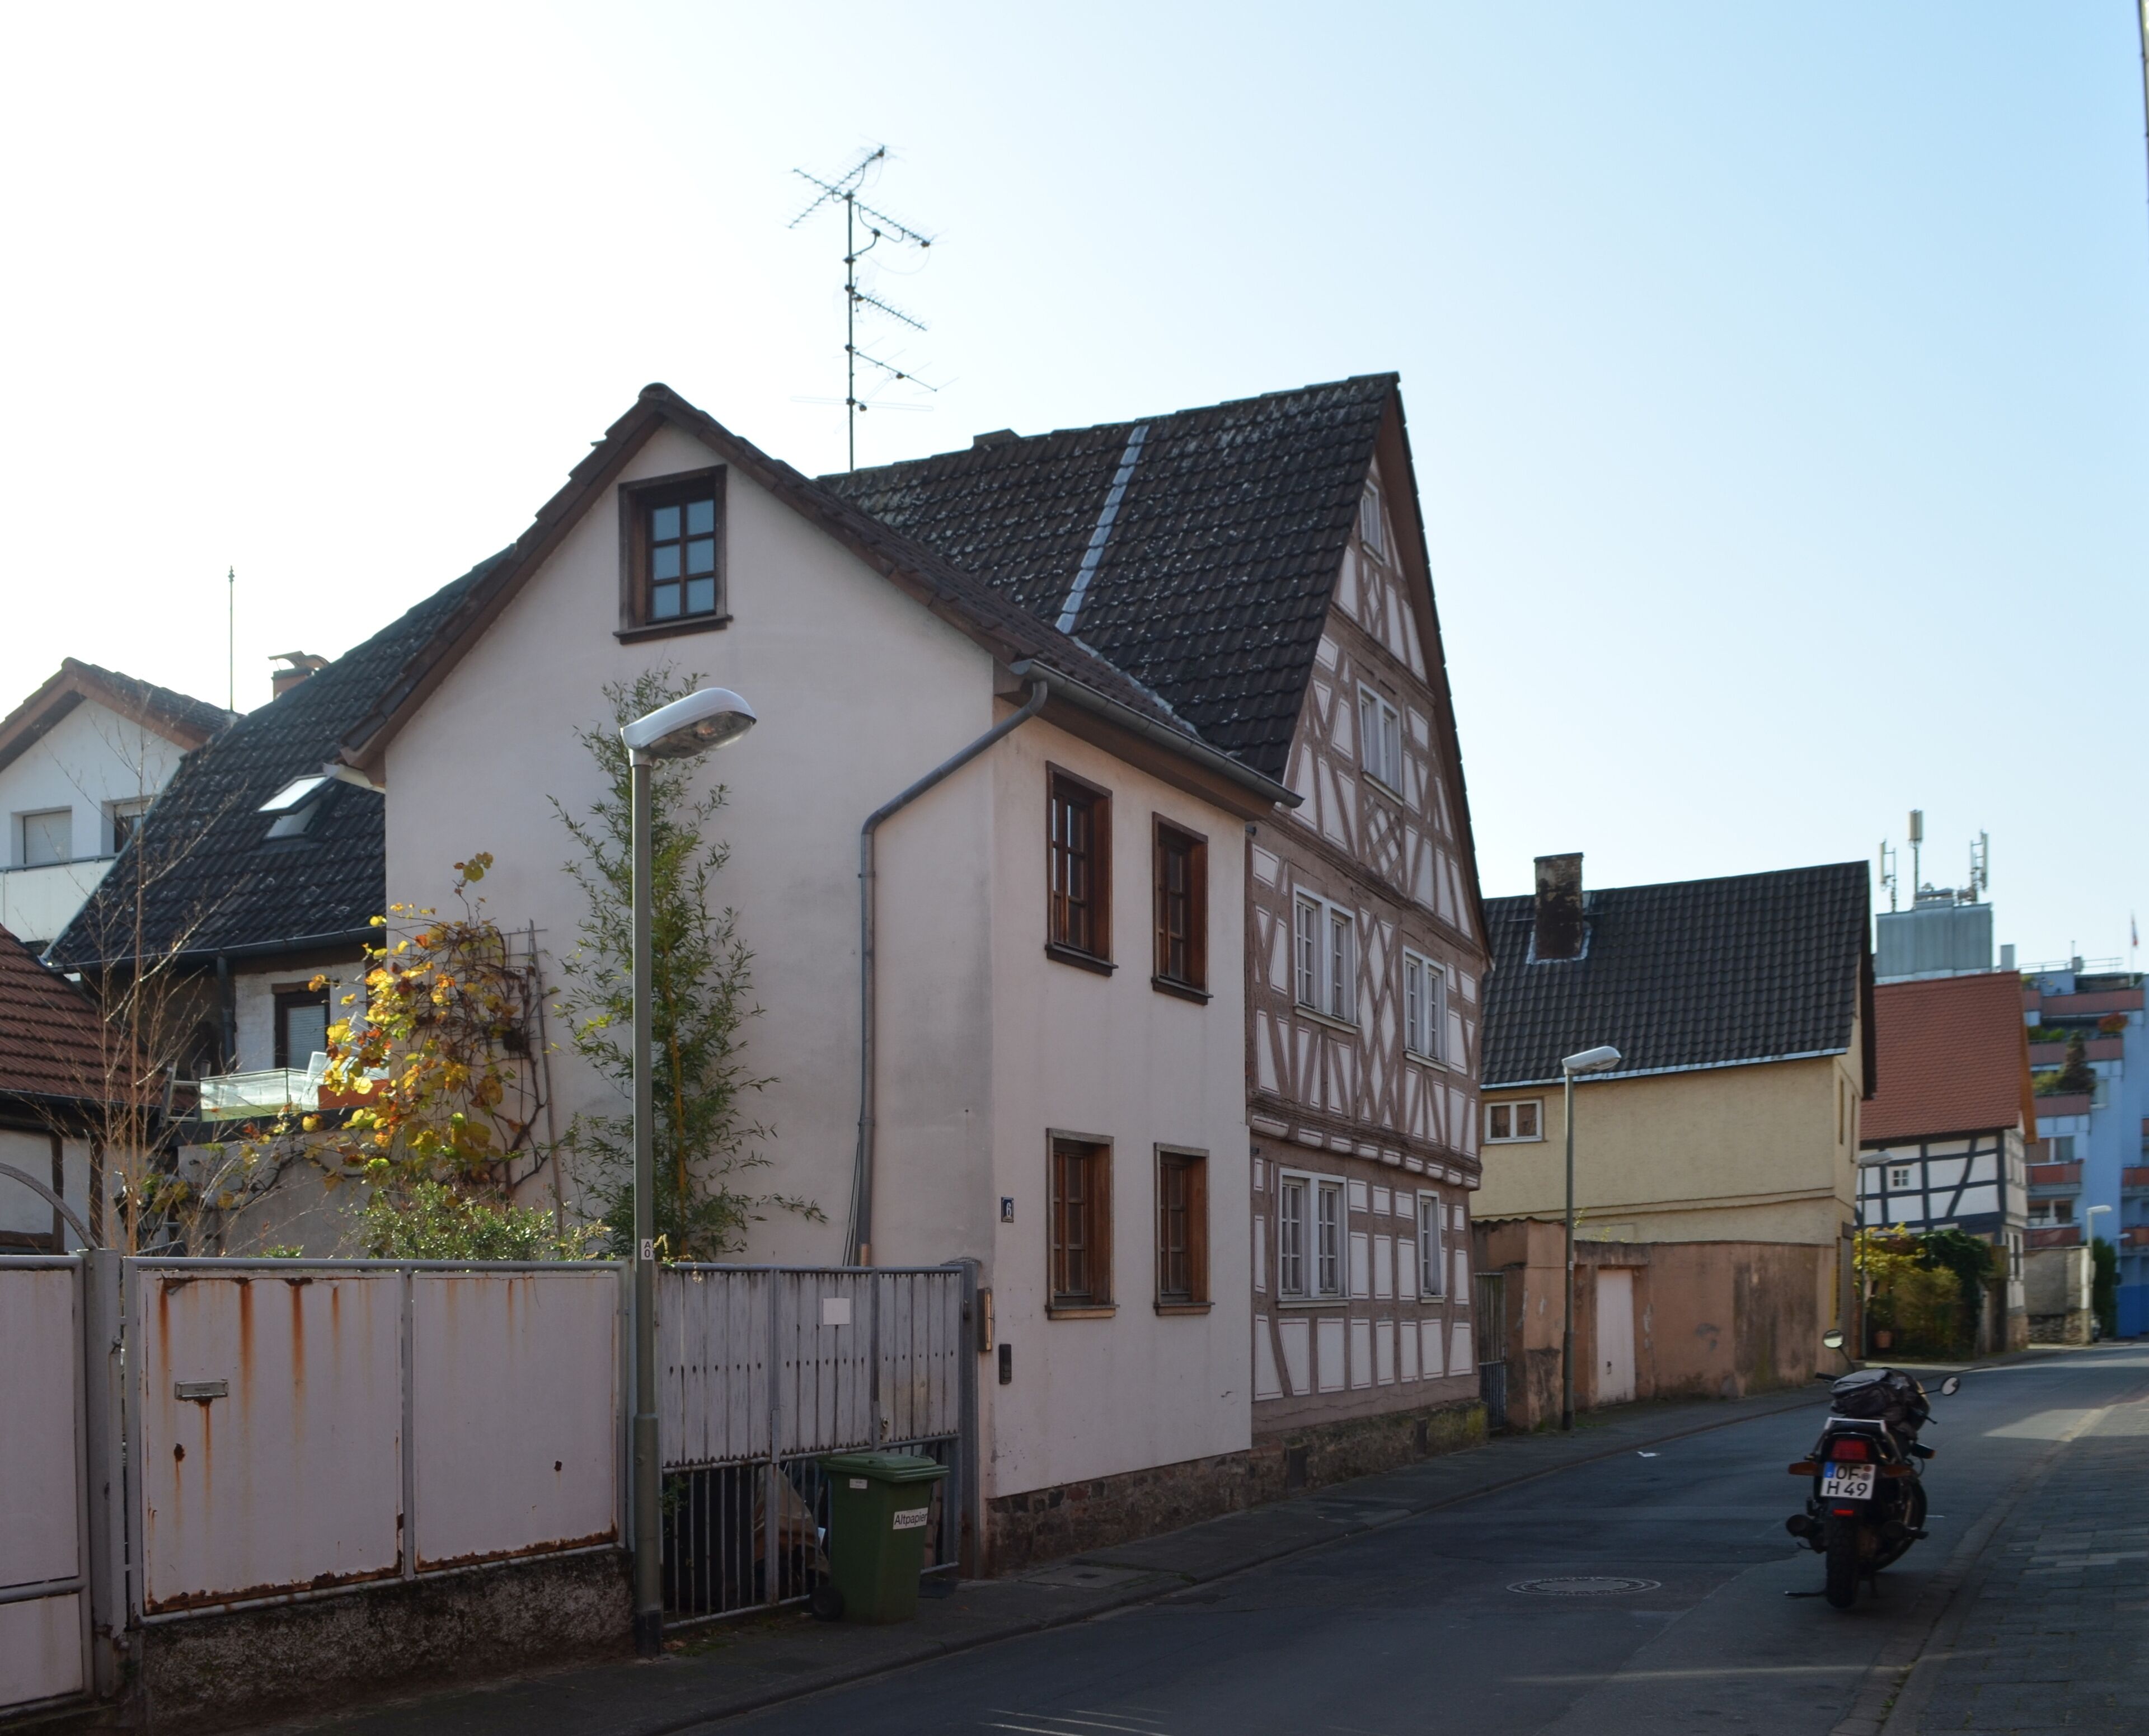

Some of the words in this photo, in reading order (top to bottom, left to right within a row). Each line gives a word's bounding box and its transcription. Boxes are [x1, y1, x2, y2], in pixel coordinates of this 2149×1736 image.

[1006, 1202, 1012, 1217] 6
[644, 1241, 651, 1249] A
[1836, 1466, 1861, 1480] OF
[1826, 1480, 1840, 1495] H
[1843, 1481, 1868, 1496] 49
[894, 1512, 927, 1527] Altpapier
